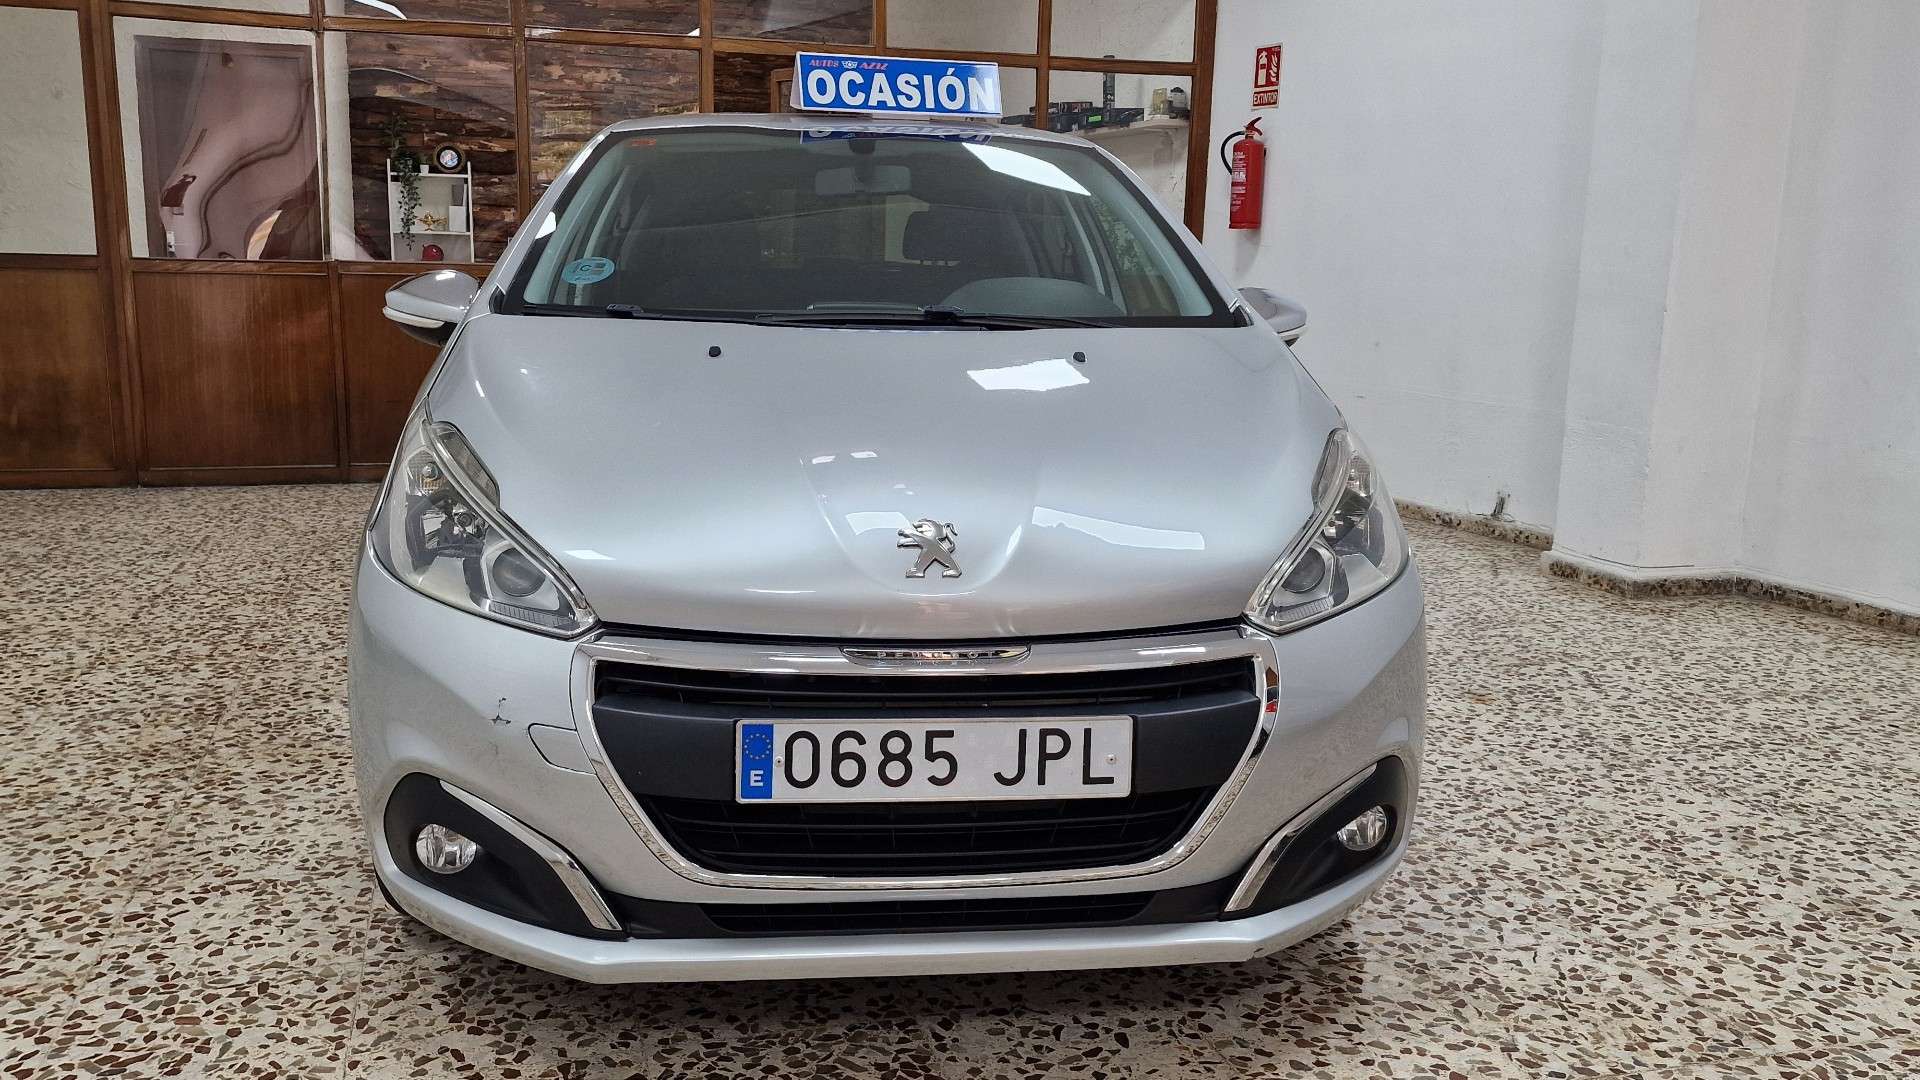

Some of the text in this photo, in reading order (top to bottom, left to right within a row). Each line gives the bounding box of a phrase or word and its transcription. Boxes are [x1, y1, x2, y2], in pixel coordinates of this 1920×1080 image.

[809, 59, 888, 71] AUTOS AZIZ
[807, 68, 996, 111] OCASIÓN
[1253, 92, 1278, 105] EXTINTOR
[784, 728, 1115, 788] 0685 JPL
[749, 769, 764, 787] E
